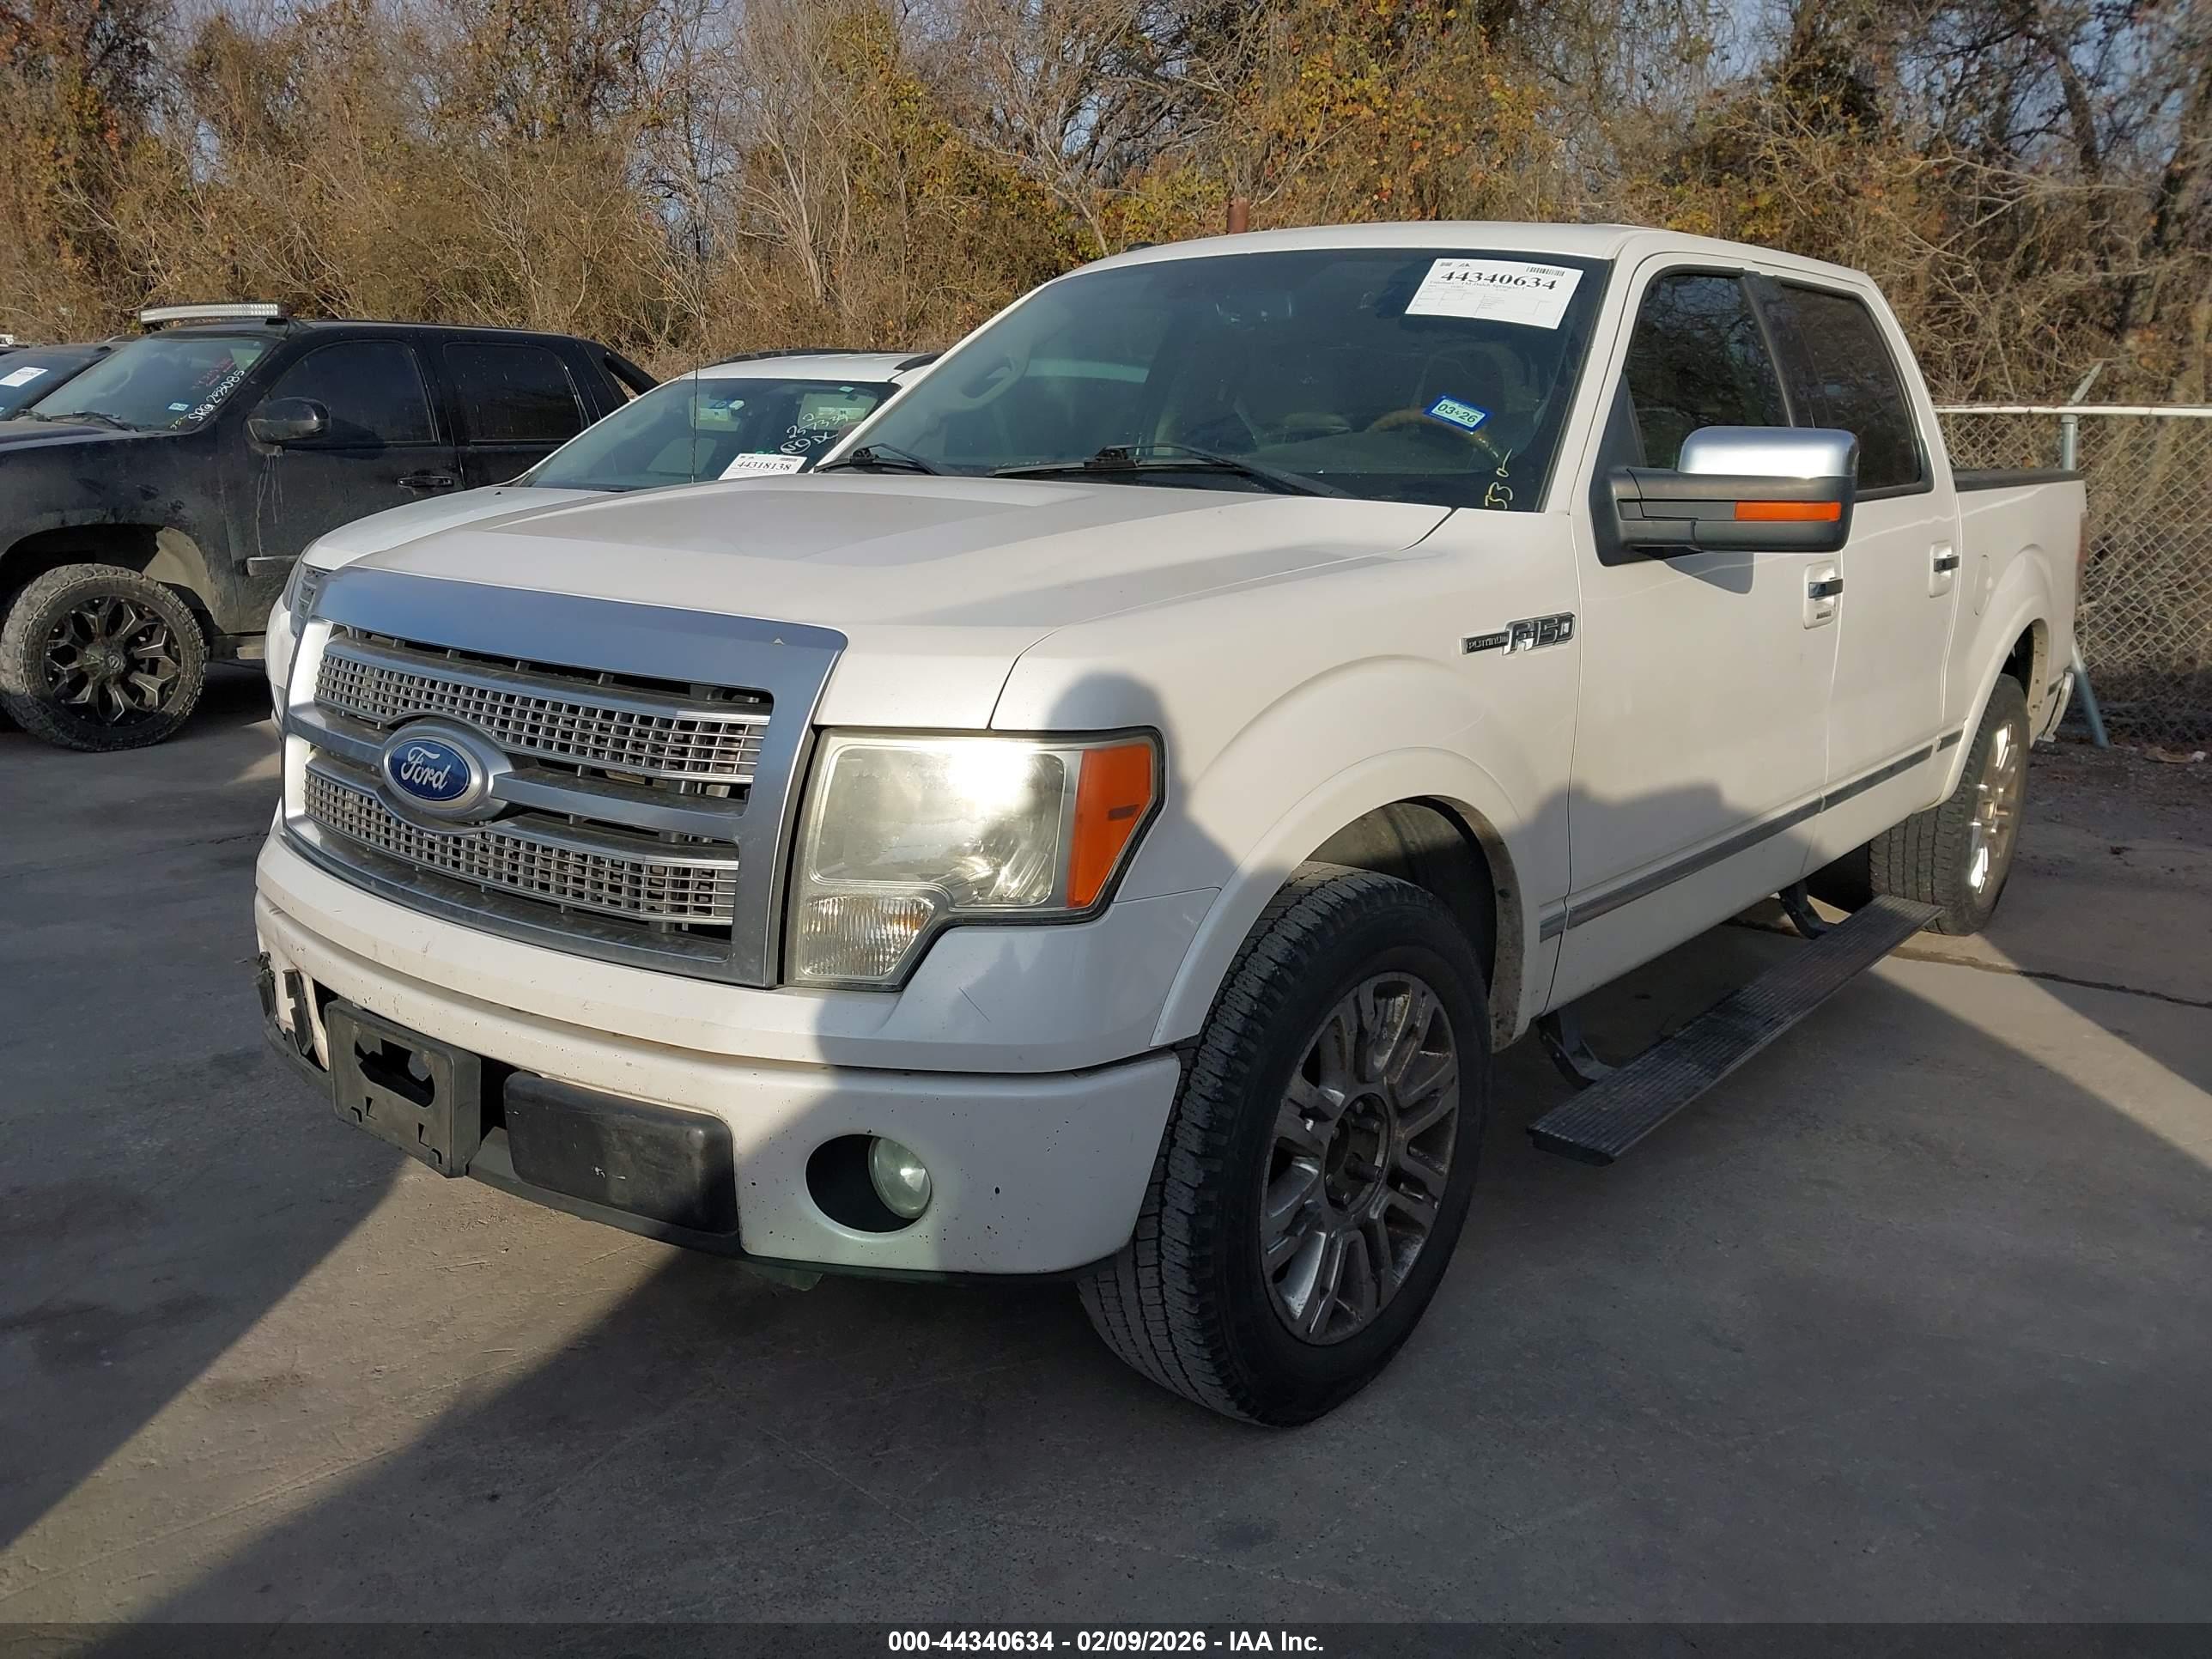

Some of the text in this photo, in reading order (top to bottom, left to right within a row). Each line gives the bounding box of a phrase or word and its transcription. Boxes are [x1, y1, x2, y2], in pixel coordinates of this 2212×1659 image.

[1441, 270, 1557, 290] 44340634
[737, 460, 792, 471] 44318138
[400, 746, 452, 791] Ford
